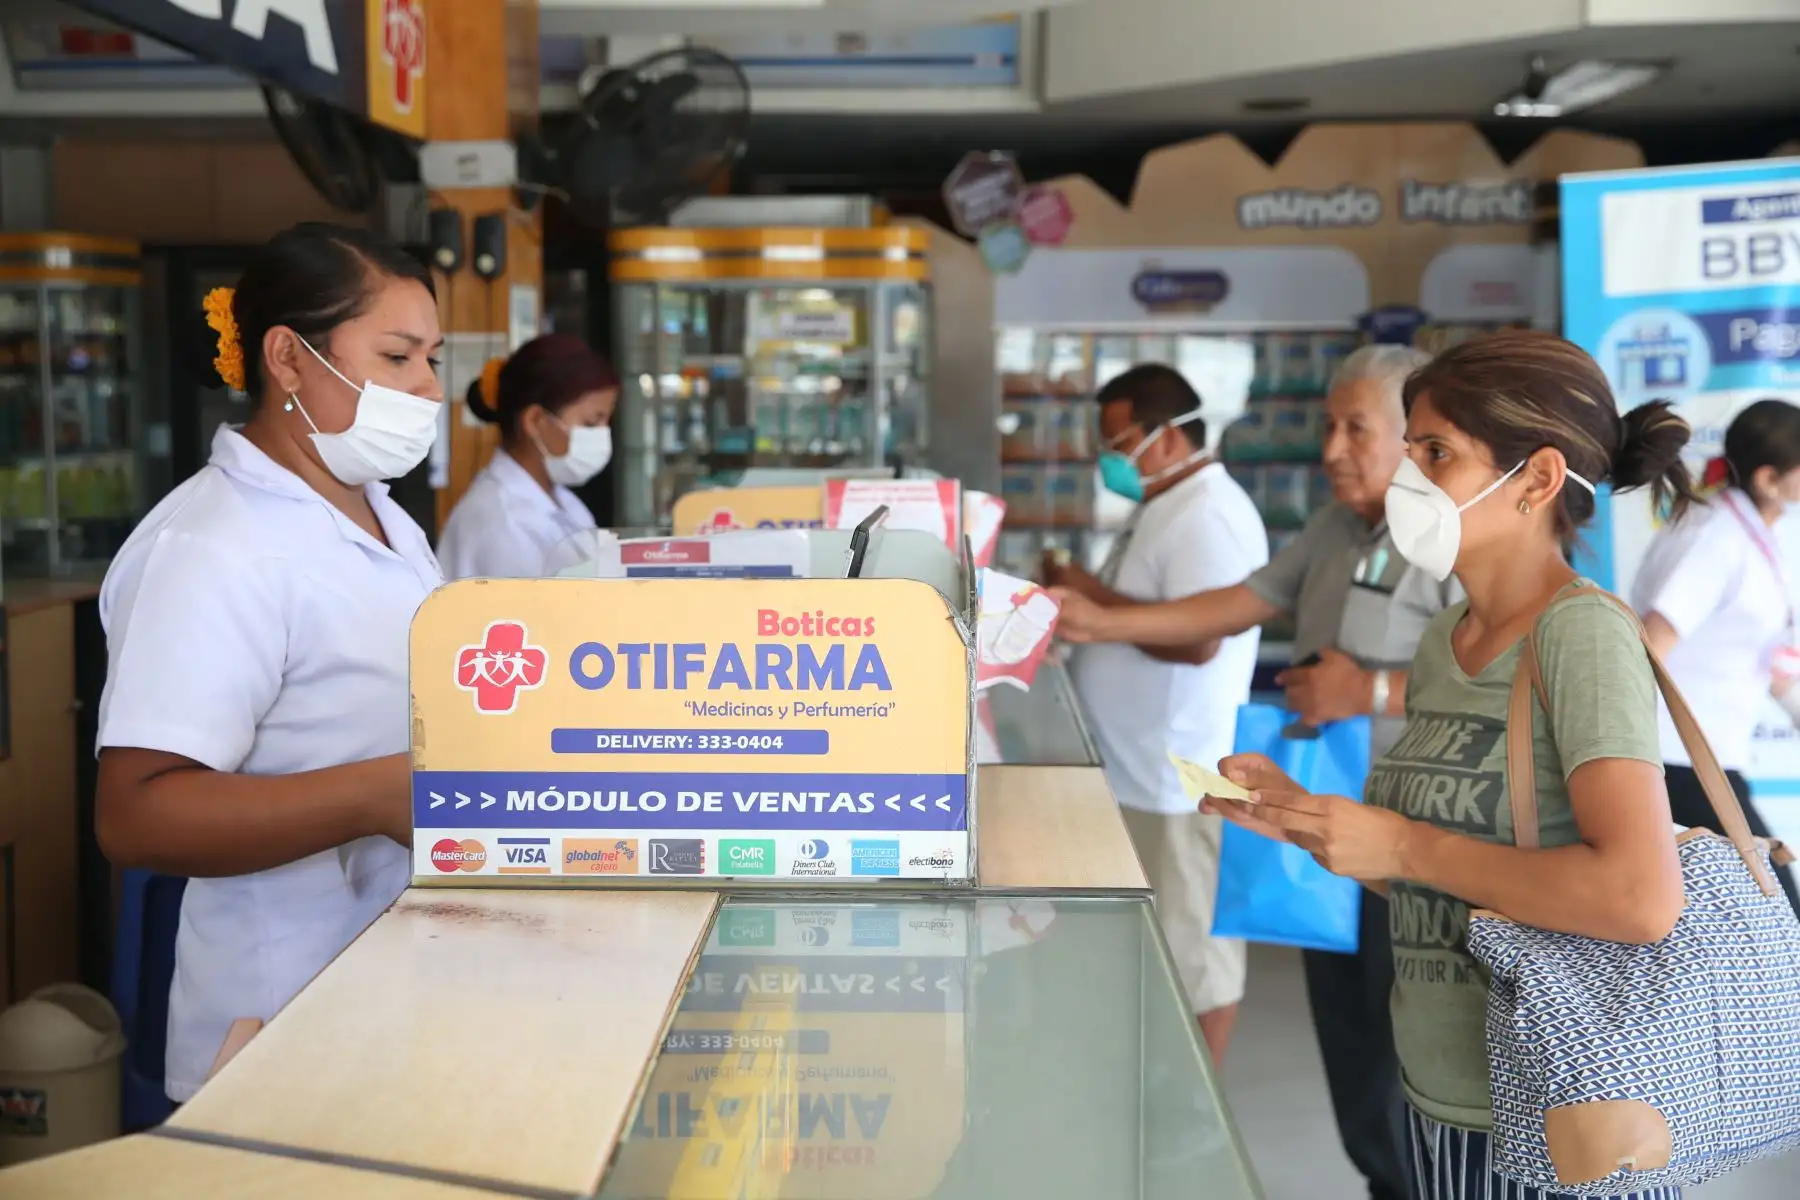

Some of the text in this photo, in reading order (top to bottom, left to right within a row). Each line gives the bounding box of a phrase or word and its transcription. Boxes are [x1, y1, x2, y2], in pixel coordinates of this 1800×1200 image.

[1238, 184, 1382, 230] mundo
[1728, 317, 1800, 358] Pag
[756, 609, 876, 637] Boticas
[569, 641, 893, 690] OTIFARMA
[778, 705, 788, 719] y
[596, 734, 784, 749] DELIVERY: 333-0404
[506, 786, 875, 813] MÓDULO DE VENTAS
[432, 850, 486, 862] MasterCard
[505, 847, 546, 864] VISA
[566, 849, 619, 864] globalnet
[729, 845, 764, 860] CMR
[852, 848, 896, 858] AMERICAN
[590, 863, 618, 871] cajero
[792, 859, 835, 869] Diners Club
[909, 857, 954, 867] efectibono
[791, 868, 836, 876] International
